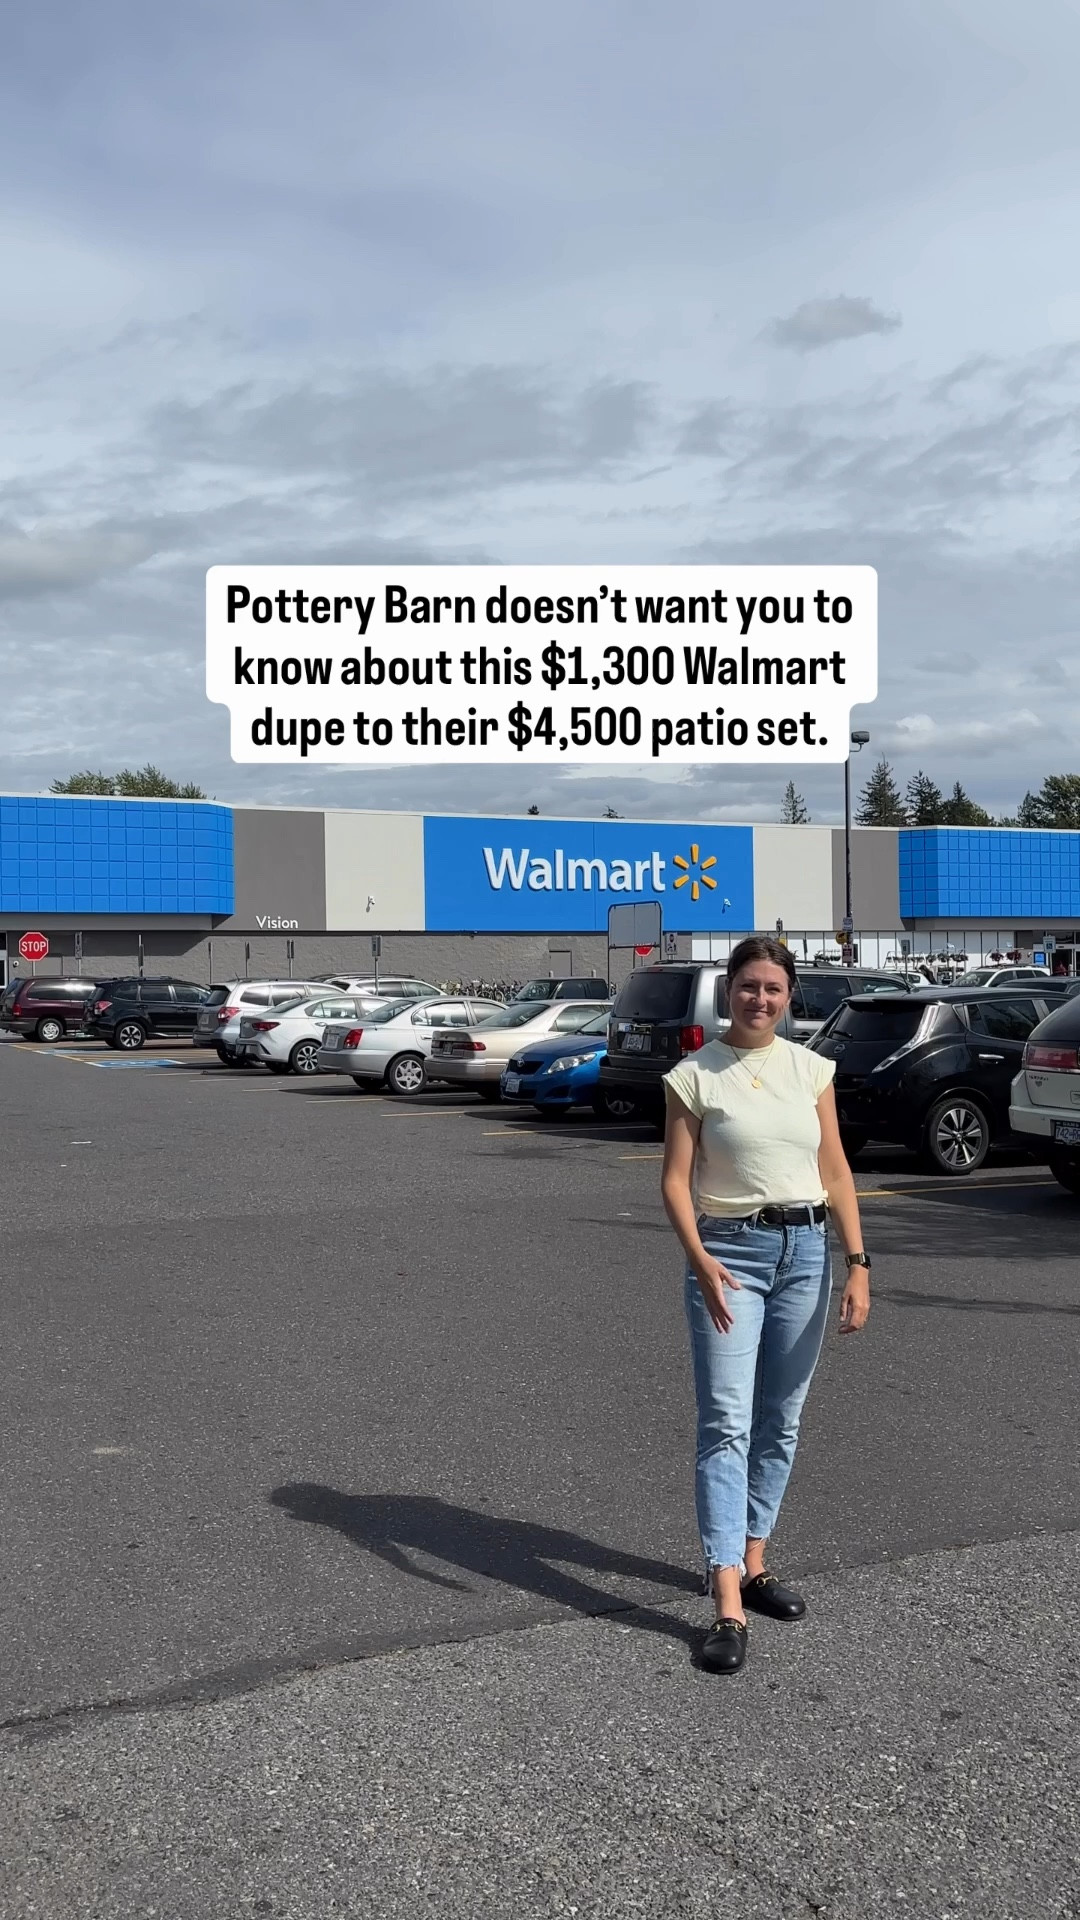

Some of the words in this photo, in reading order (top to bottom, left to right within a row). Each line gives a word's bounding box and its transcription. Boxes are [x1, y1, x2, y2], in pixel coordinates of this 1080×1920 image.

[483, 848, 666, 891] Walmart
[256, 915, 299, 929] Vision
[21, 941, 47, 952] STOP
